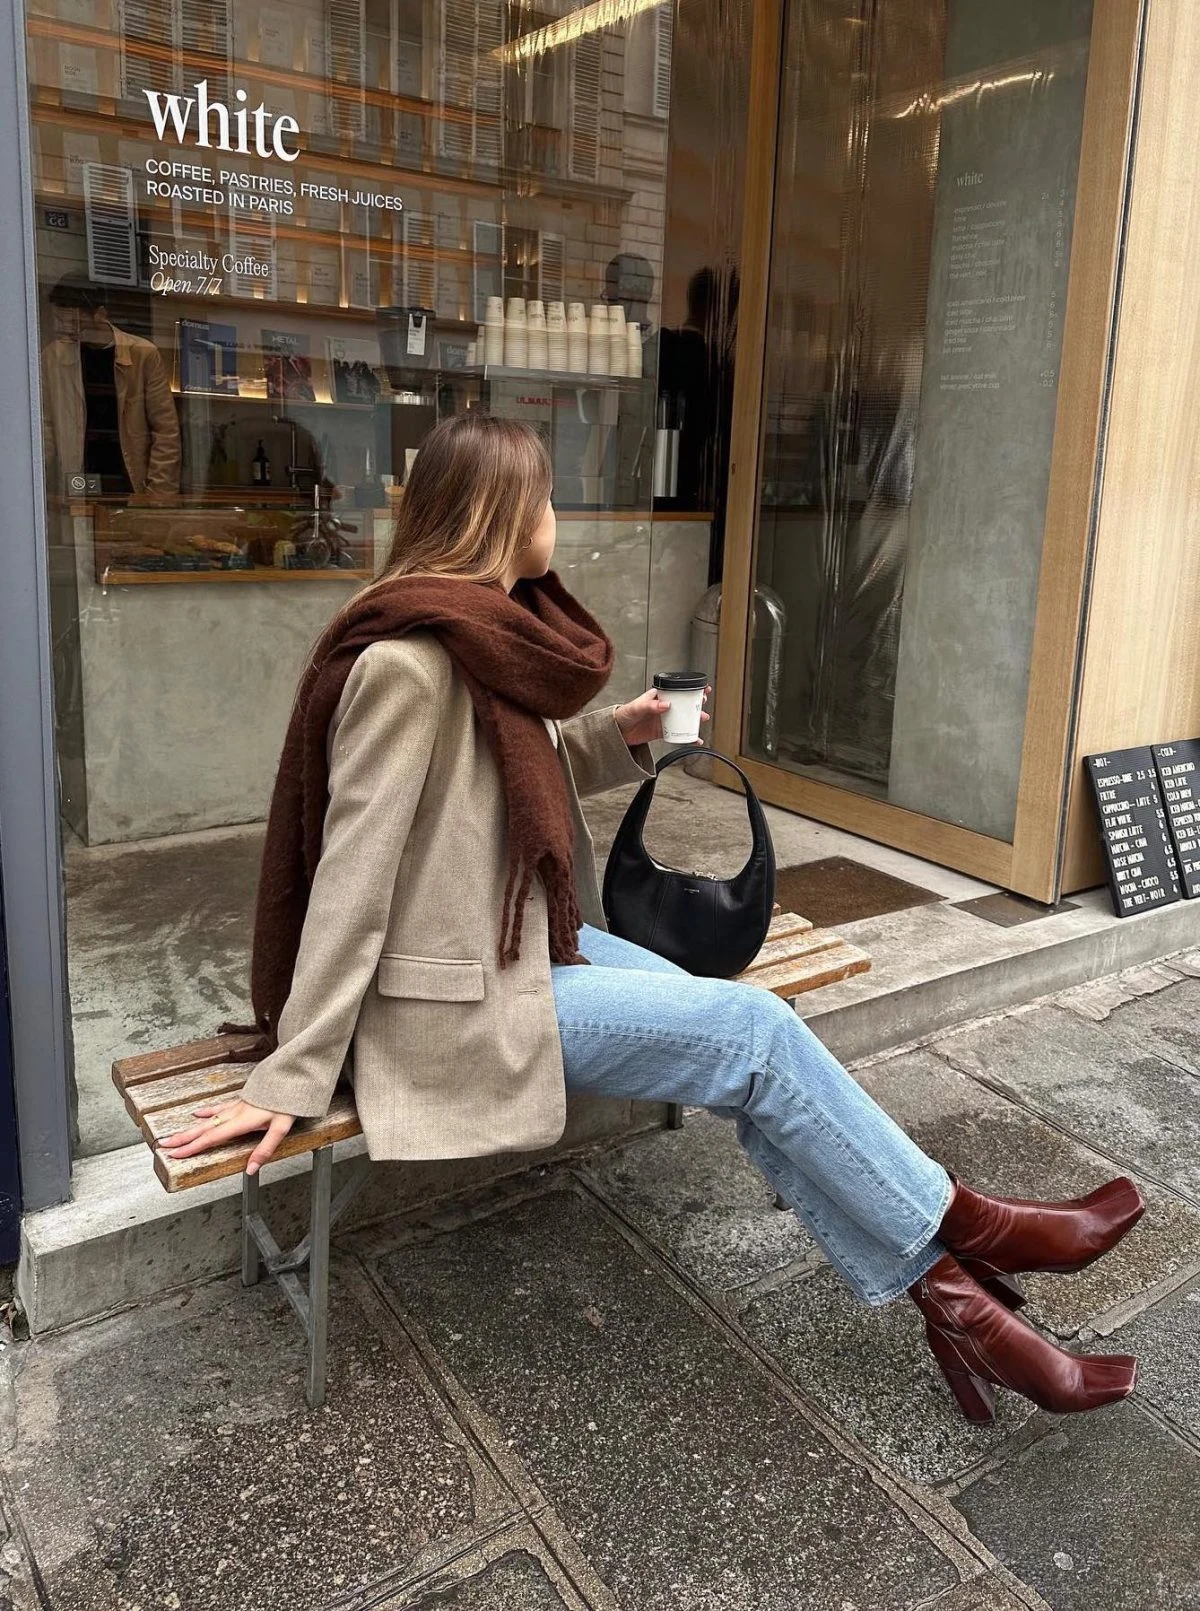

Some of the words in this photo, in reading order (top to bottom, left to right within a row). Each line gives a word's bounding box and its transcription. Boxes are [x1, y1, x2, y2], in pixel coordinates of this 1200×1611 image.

[142, 79, 300, 162] white
[145, 159, 215, 185] COFFEE,
[220, 169, 297, 198] PASTRIES,
[300, 183, 349, 202] FRESH
[351, 192, 403, 211] JUICES
[957, 171, 984, 188] white
[146, 180, 224, 205] ROASTED
[229, 193, 246, 208] IN
[250, 196, 294, 215] PARIS
[149, 245, 218, 274] Specialty
[222, 254, 269, 277] Coffee
[150, 272, 192, 295] Open
[196, 277, 222, 295] 7/7
[271, 335, 300, 345] METAL
[1136, 796, 1151, 807] LATTE
[1153, 794, 1158, 804] 5
[1129, 825, 1144, 837] LATTE
[1161, 832, 1167, 842] 6
